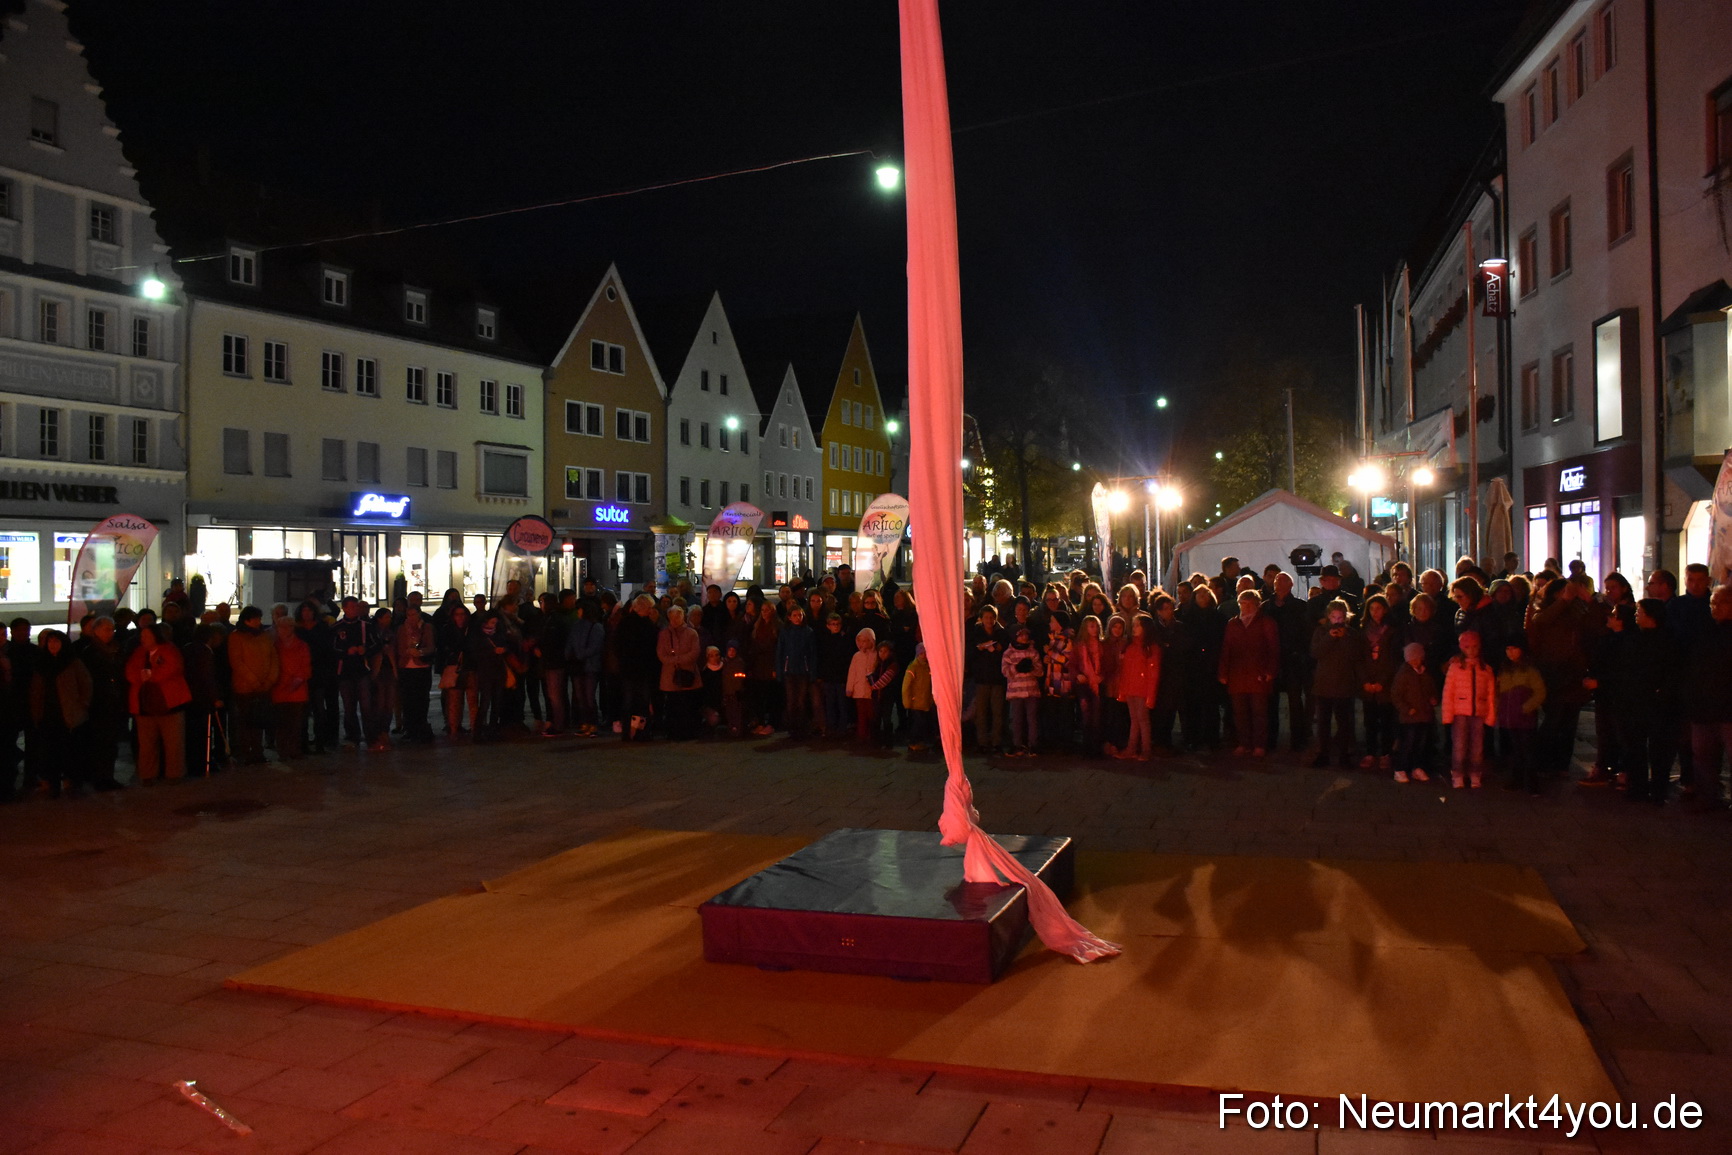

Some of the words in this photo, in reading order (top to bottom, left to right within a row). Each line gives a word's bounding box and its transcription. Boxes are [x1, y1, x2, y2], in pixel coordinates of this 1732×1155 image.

[1486, 271, 1501, 313] Achatz
[54, 367, 110, 389] WEBER
[52, 483, 119, 505] WEBER
[107, 518, 148, 530] Salsa
[712, 525, 754, 537] ARTICO
[863, 519, 903, 532] ARTICO
